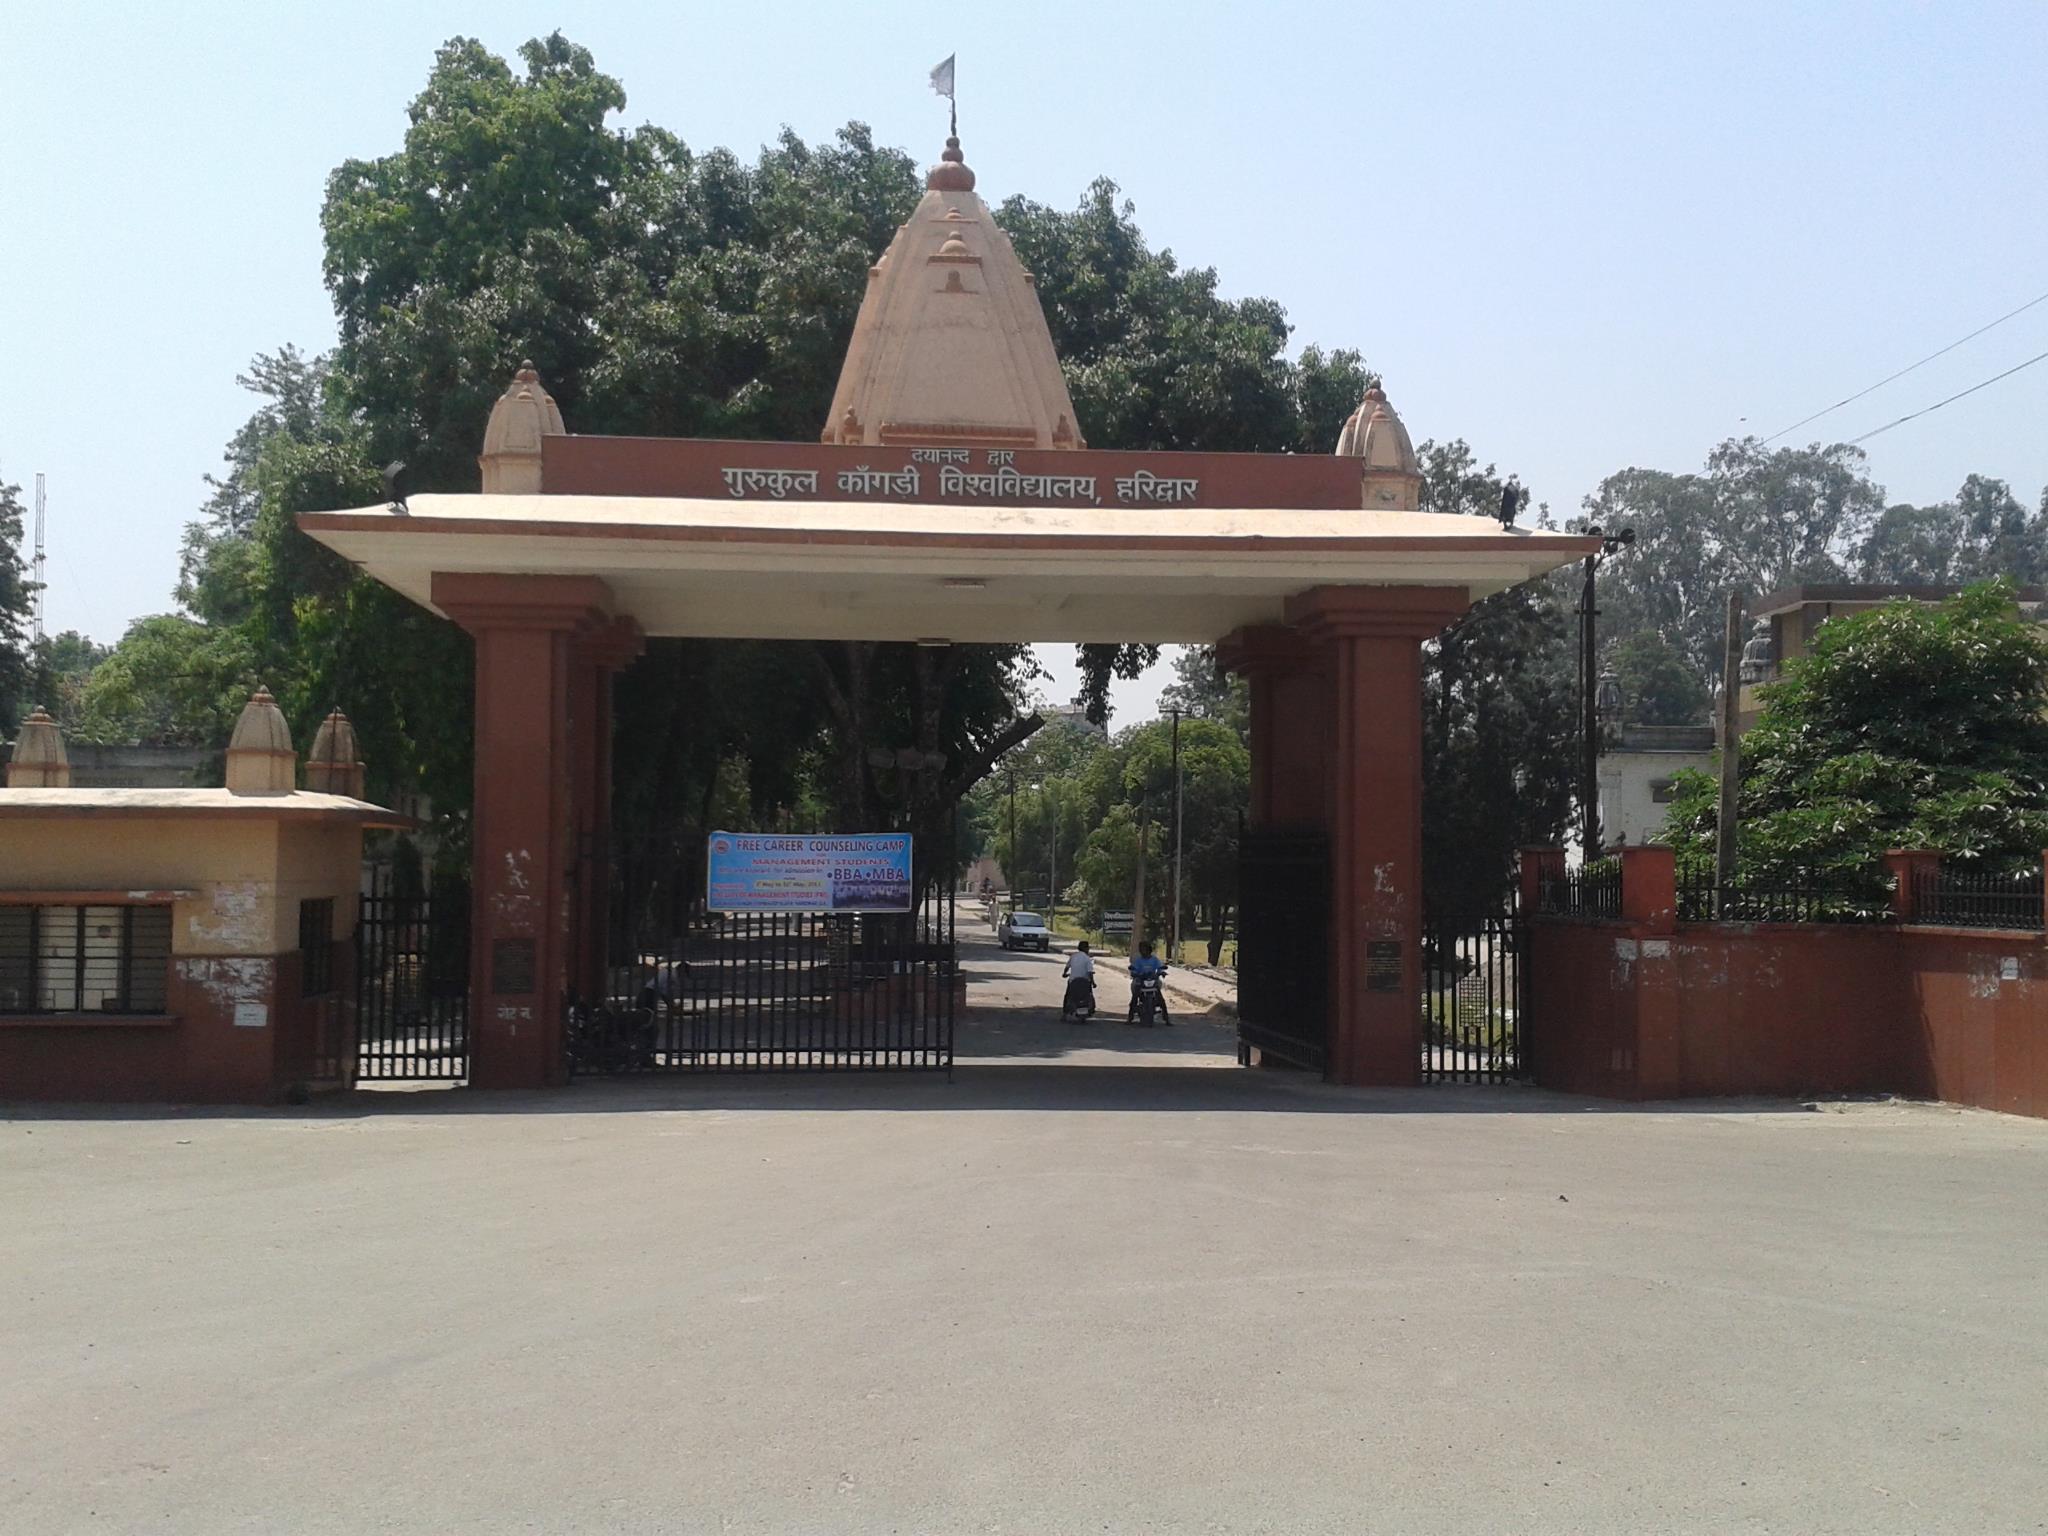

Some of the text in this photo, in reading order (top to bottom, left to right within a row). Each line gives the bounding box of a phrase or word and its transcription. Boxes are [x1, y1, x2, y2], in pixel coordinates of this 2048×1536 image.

[911, 449, 1015, 465] दयानन्द द्वार
[721, 467, 819, 498] गुरुकुल
[1115, 470, 1199, 503] हरिद्वार
[736, 840, 905, 852] FREE CAREER COUNSELING CAMP
[835, 858, 890, 866] STUDENTS
[834, 868, 905, 880] BBA MBA
